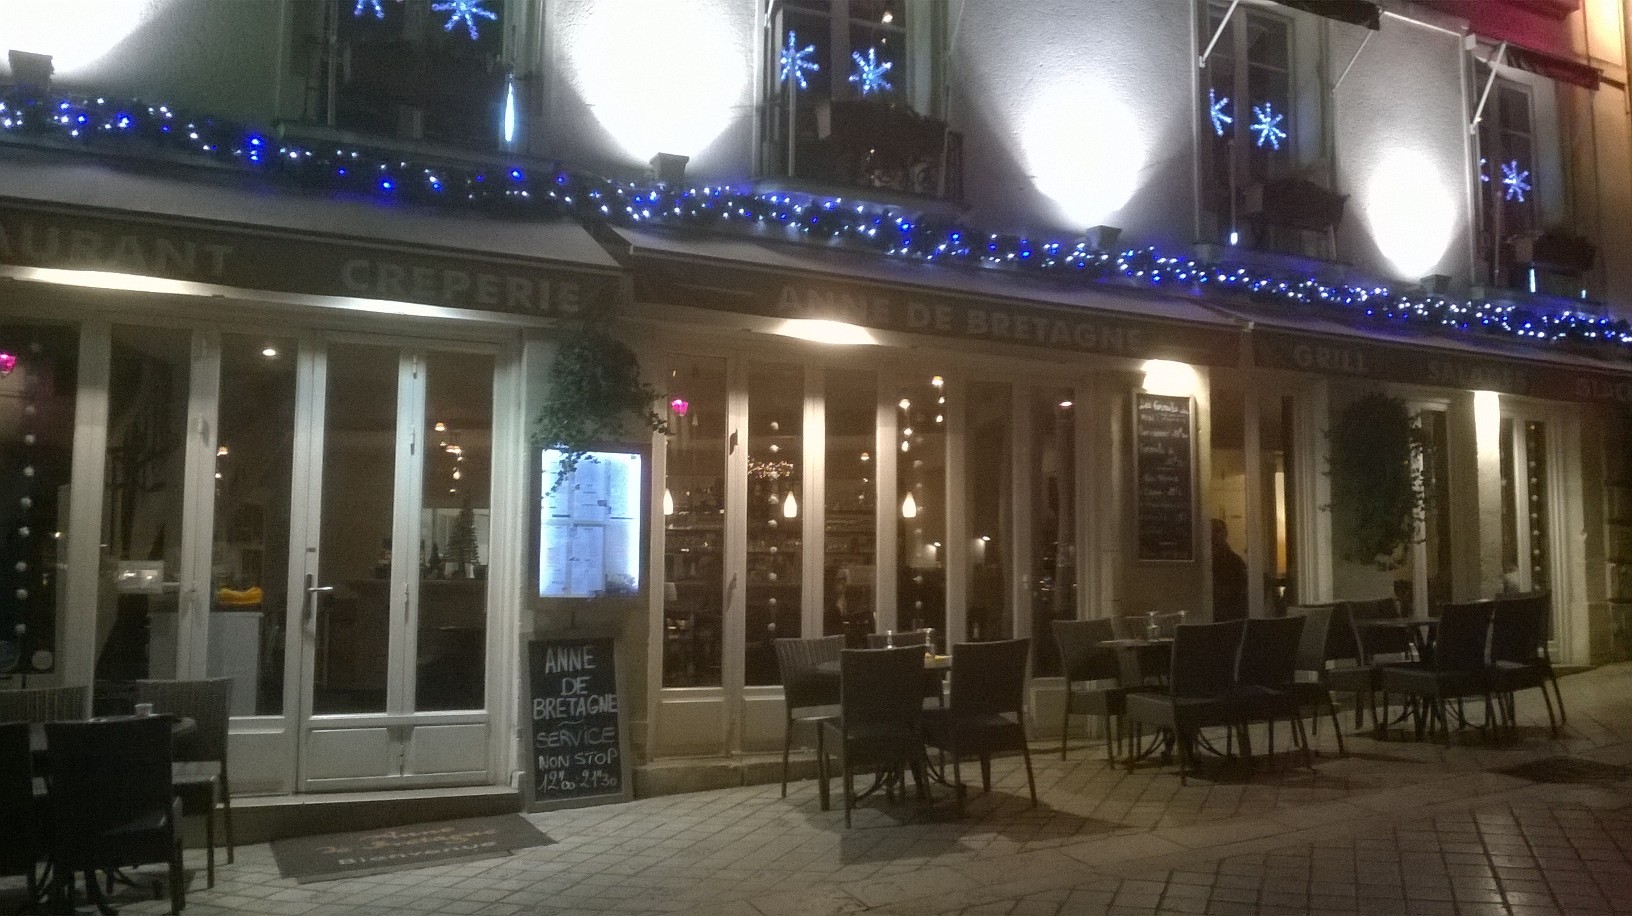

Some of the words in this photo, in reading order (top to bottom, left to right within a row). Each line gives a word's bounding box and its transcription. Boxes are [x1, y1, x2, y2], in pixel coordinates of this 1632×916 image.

[341, 259, 581, 312] CREPERIE
[775, 285, 890, 325] ANNE
[907, 302, 953, 330] DE
[967, 309, 1142, 352] BRETAGNE
[1293, 344, 1369, 374] GRILL
[546, 646, 595, 673] ANNE
[560, 676, 590, 695] DE
[533, 694, 618, 720] BRETAGNE
[539, 755, 570, 771] NON
[574, 748, 617, 765] STOP
